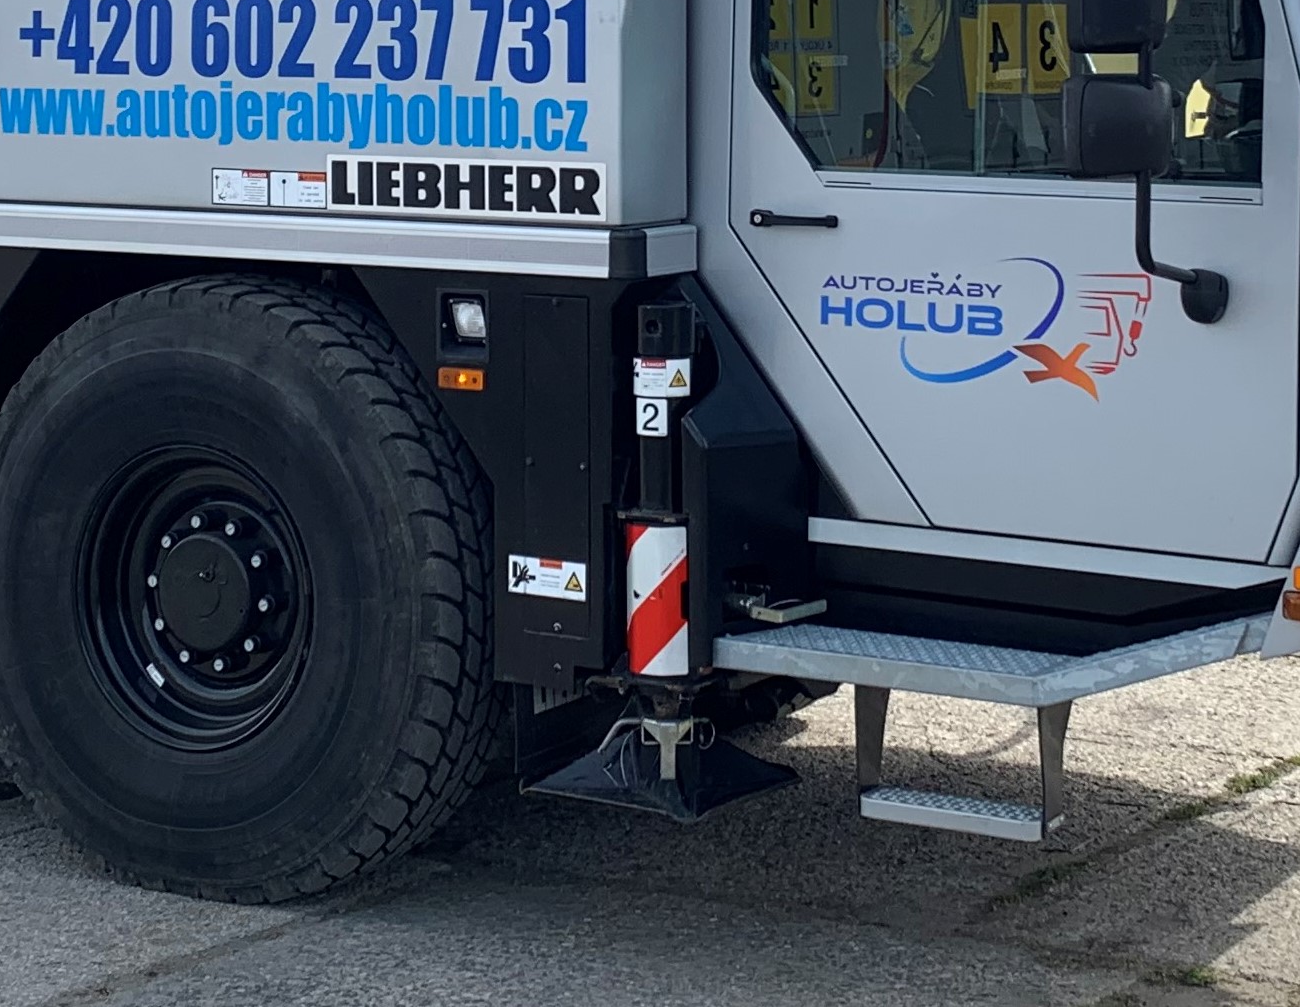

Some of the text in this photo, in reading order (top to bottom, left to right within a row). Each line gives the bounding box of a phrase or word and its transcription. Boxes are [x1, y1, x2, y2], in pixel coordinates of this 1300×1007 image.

[331, 160, 601, 216] LIEBHERR
[822, 272, 1002, 299] AUTOJEŘÁBY
[820, 295, 1004, 337] HOLUB
[642, 402, 660, 432] 2
